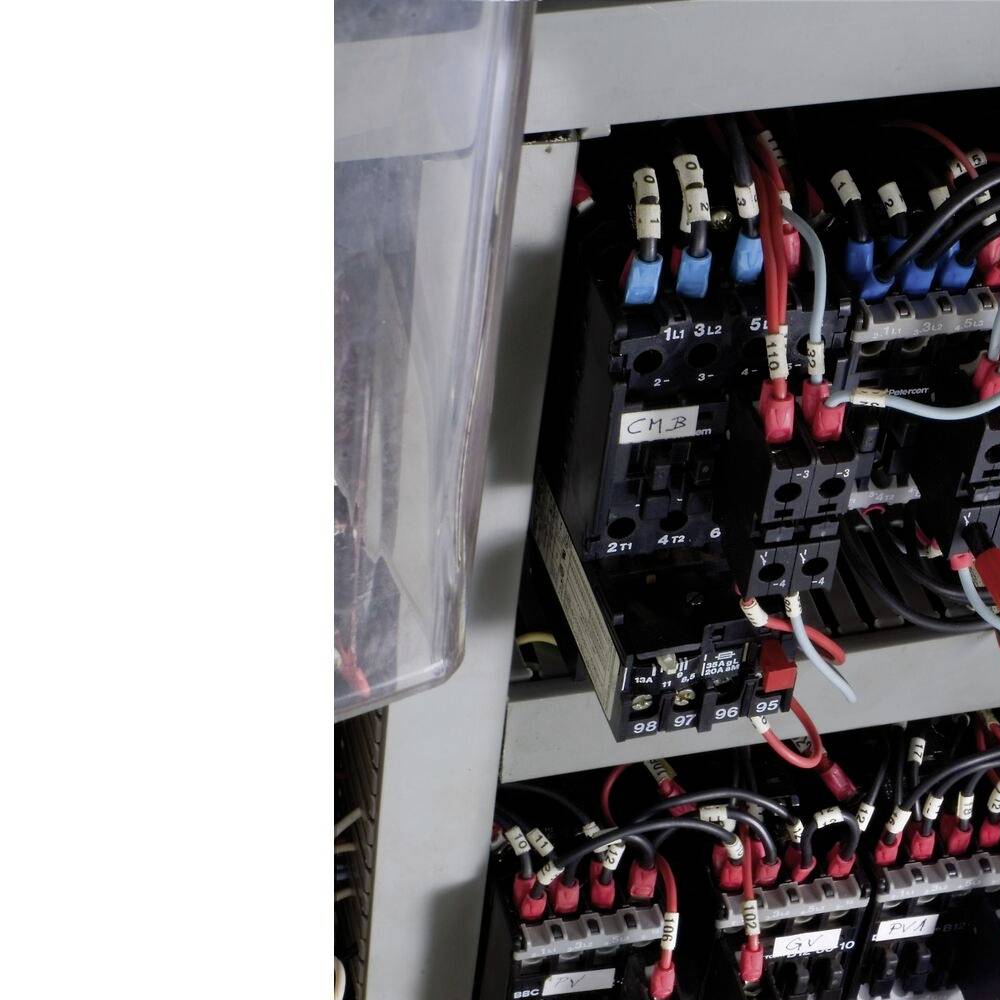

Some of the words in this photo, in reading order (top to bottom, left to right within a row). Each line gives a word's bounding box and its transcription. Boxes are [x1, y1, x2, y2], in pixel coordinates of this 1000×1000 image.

[663, 326, 685, 341] 1L1
[693, 323, 723, 338] 3L2
[767, 341, 779, 371] 110
[657, 534, 685, 545] 4T2
[709, 527, 722, 539] 6
[606, 542, 633, 553] 2T1
[634, 675, 654, 684] 13A
[633, 720, 658, 734] 98
[673, 714, 696, 728] 97
[715, 706, 739, 720] 96
[755, 699, 779, 713] 95
[513, 833, 527, 849] 10
[535, 834, 548, 849] 11
[605, 848, 616, 865] 12
[744, 905, 756, 929] 102
[662, 915, 674, 943] 106
[889, 918, 927, 935] PV1
[513, 988, 539, 999] BBC
